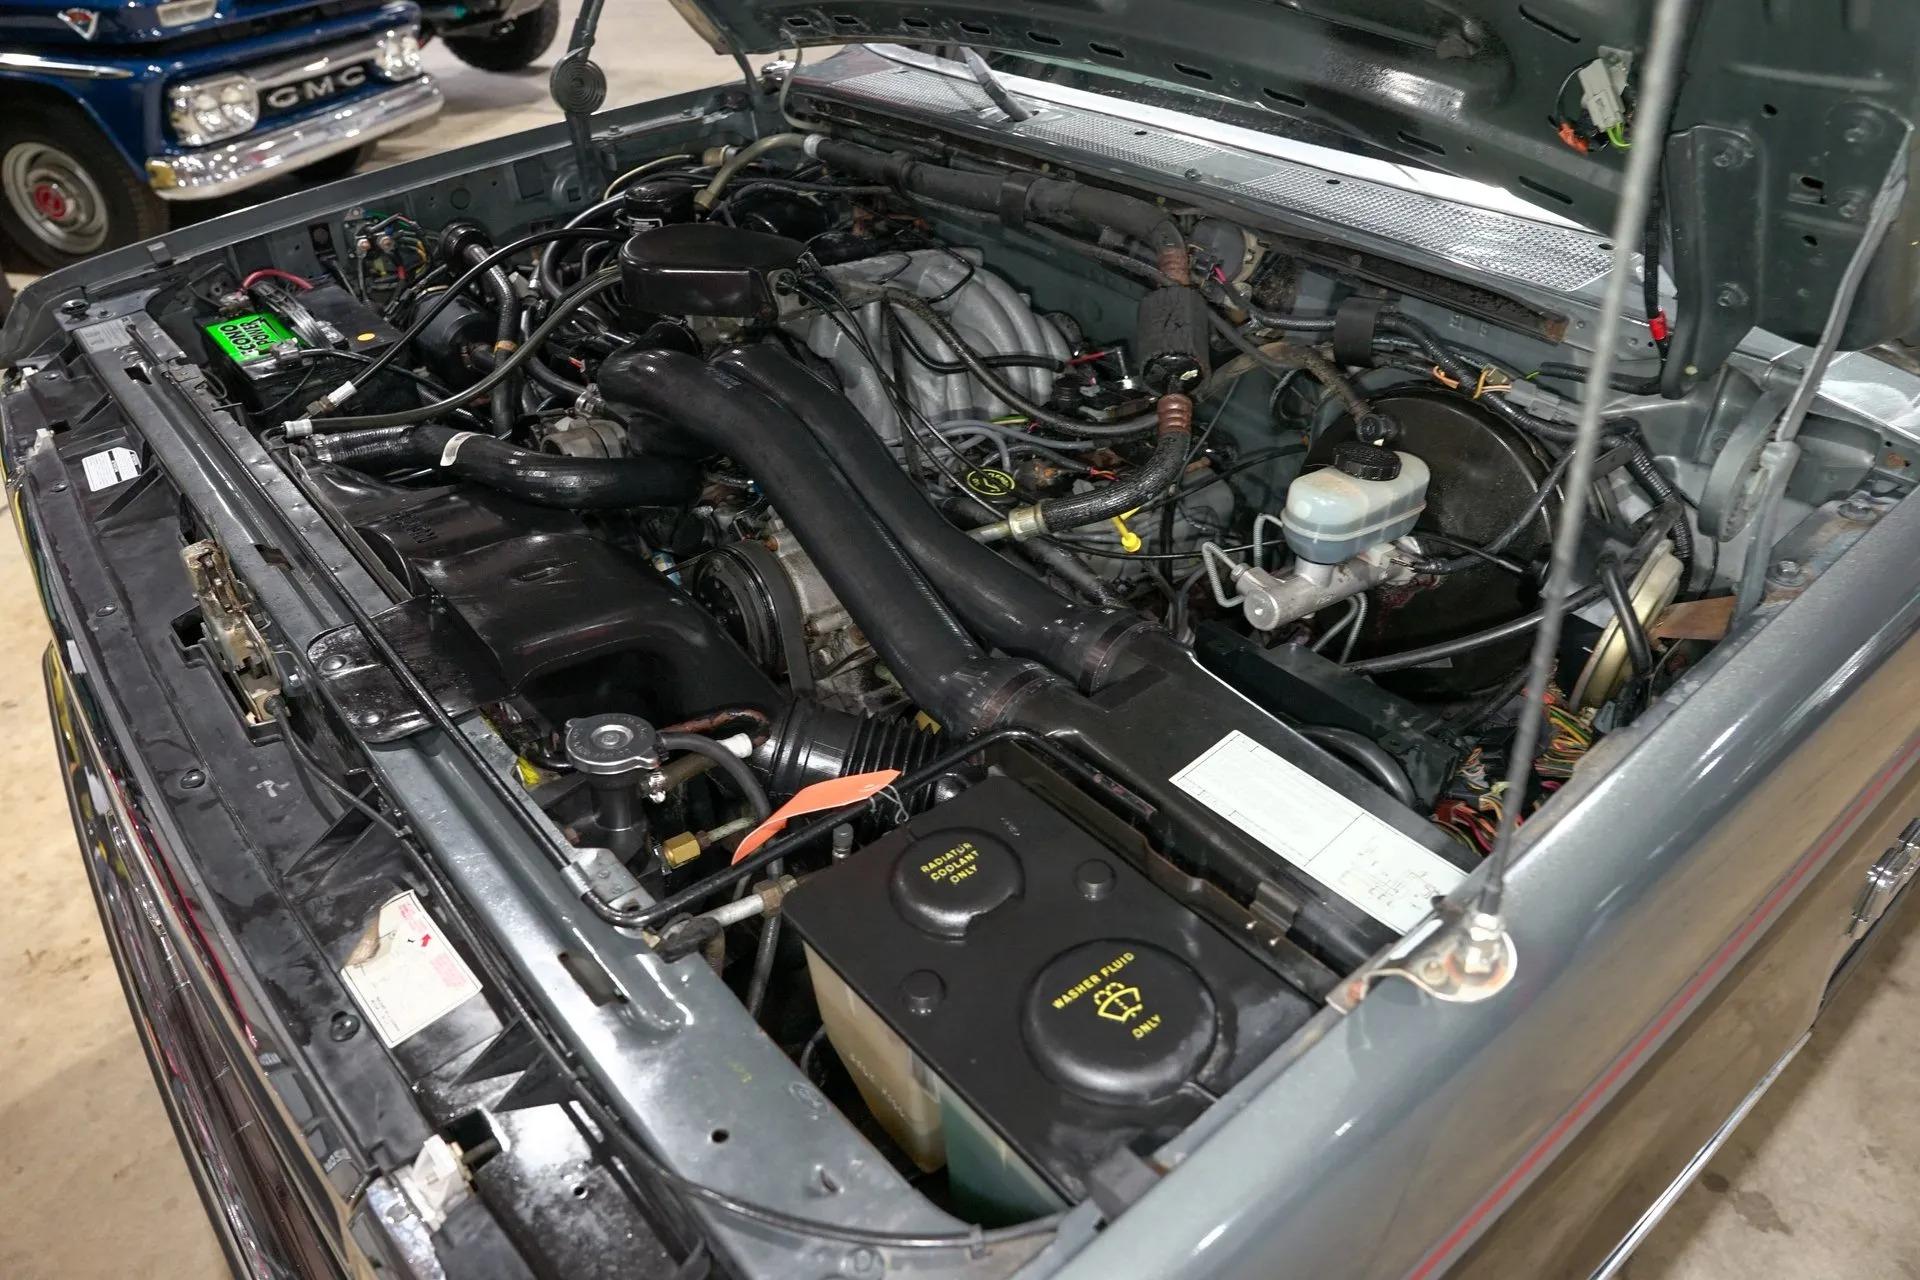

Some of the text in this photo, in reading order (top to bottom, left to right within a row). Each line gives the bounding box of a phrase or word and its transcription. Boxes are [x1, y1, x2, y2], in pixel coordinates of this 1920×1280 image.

[266, 66, 366, 107] GMC
[239, 319, 274, 346] POWER
[920, 842, 972, 872] RADIATOR
[930, 850, 979, 881] COOLANT
[949, 864, 977, 883] ONLY
[1052, 952, 1135, 1009] WASHER FLUID
[1132, 1014, 1161, 1039] ONLY
